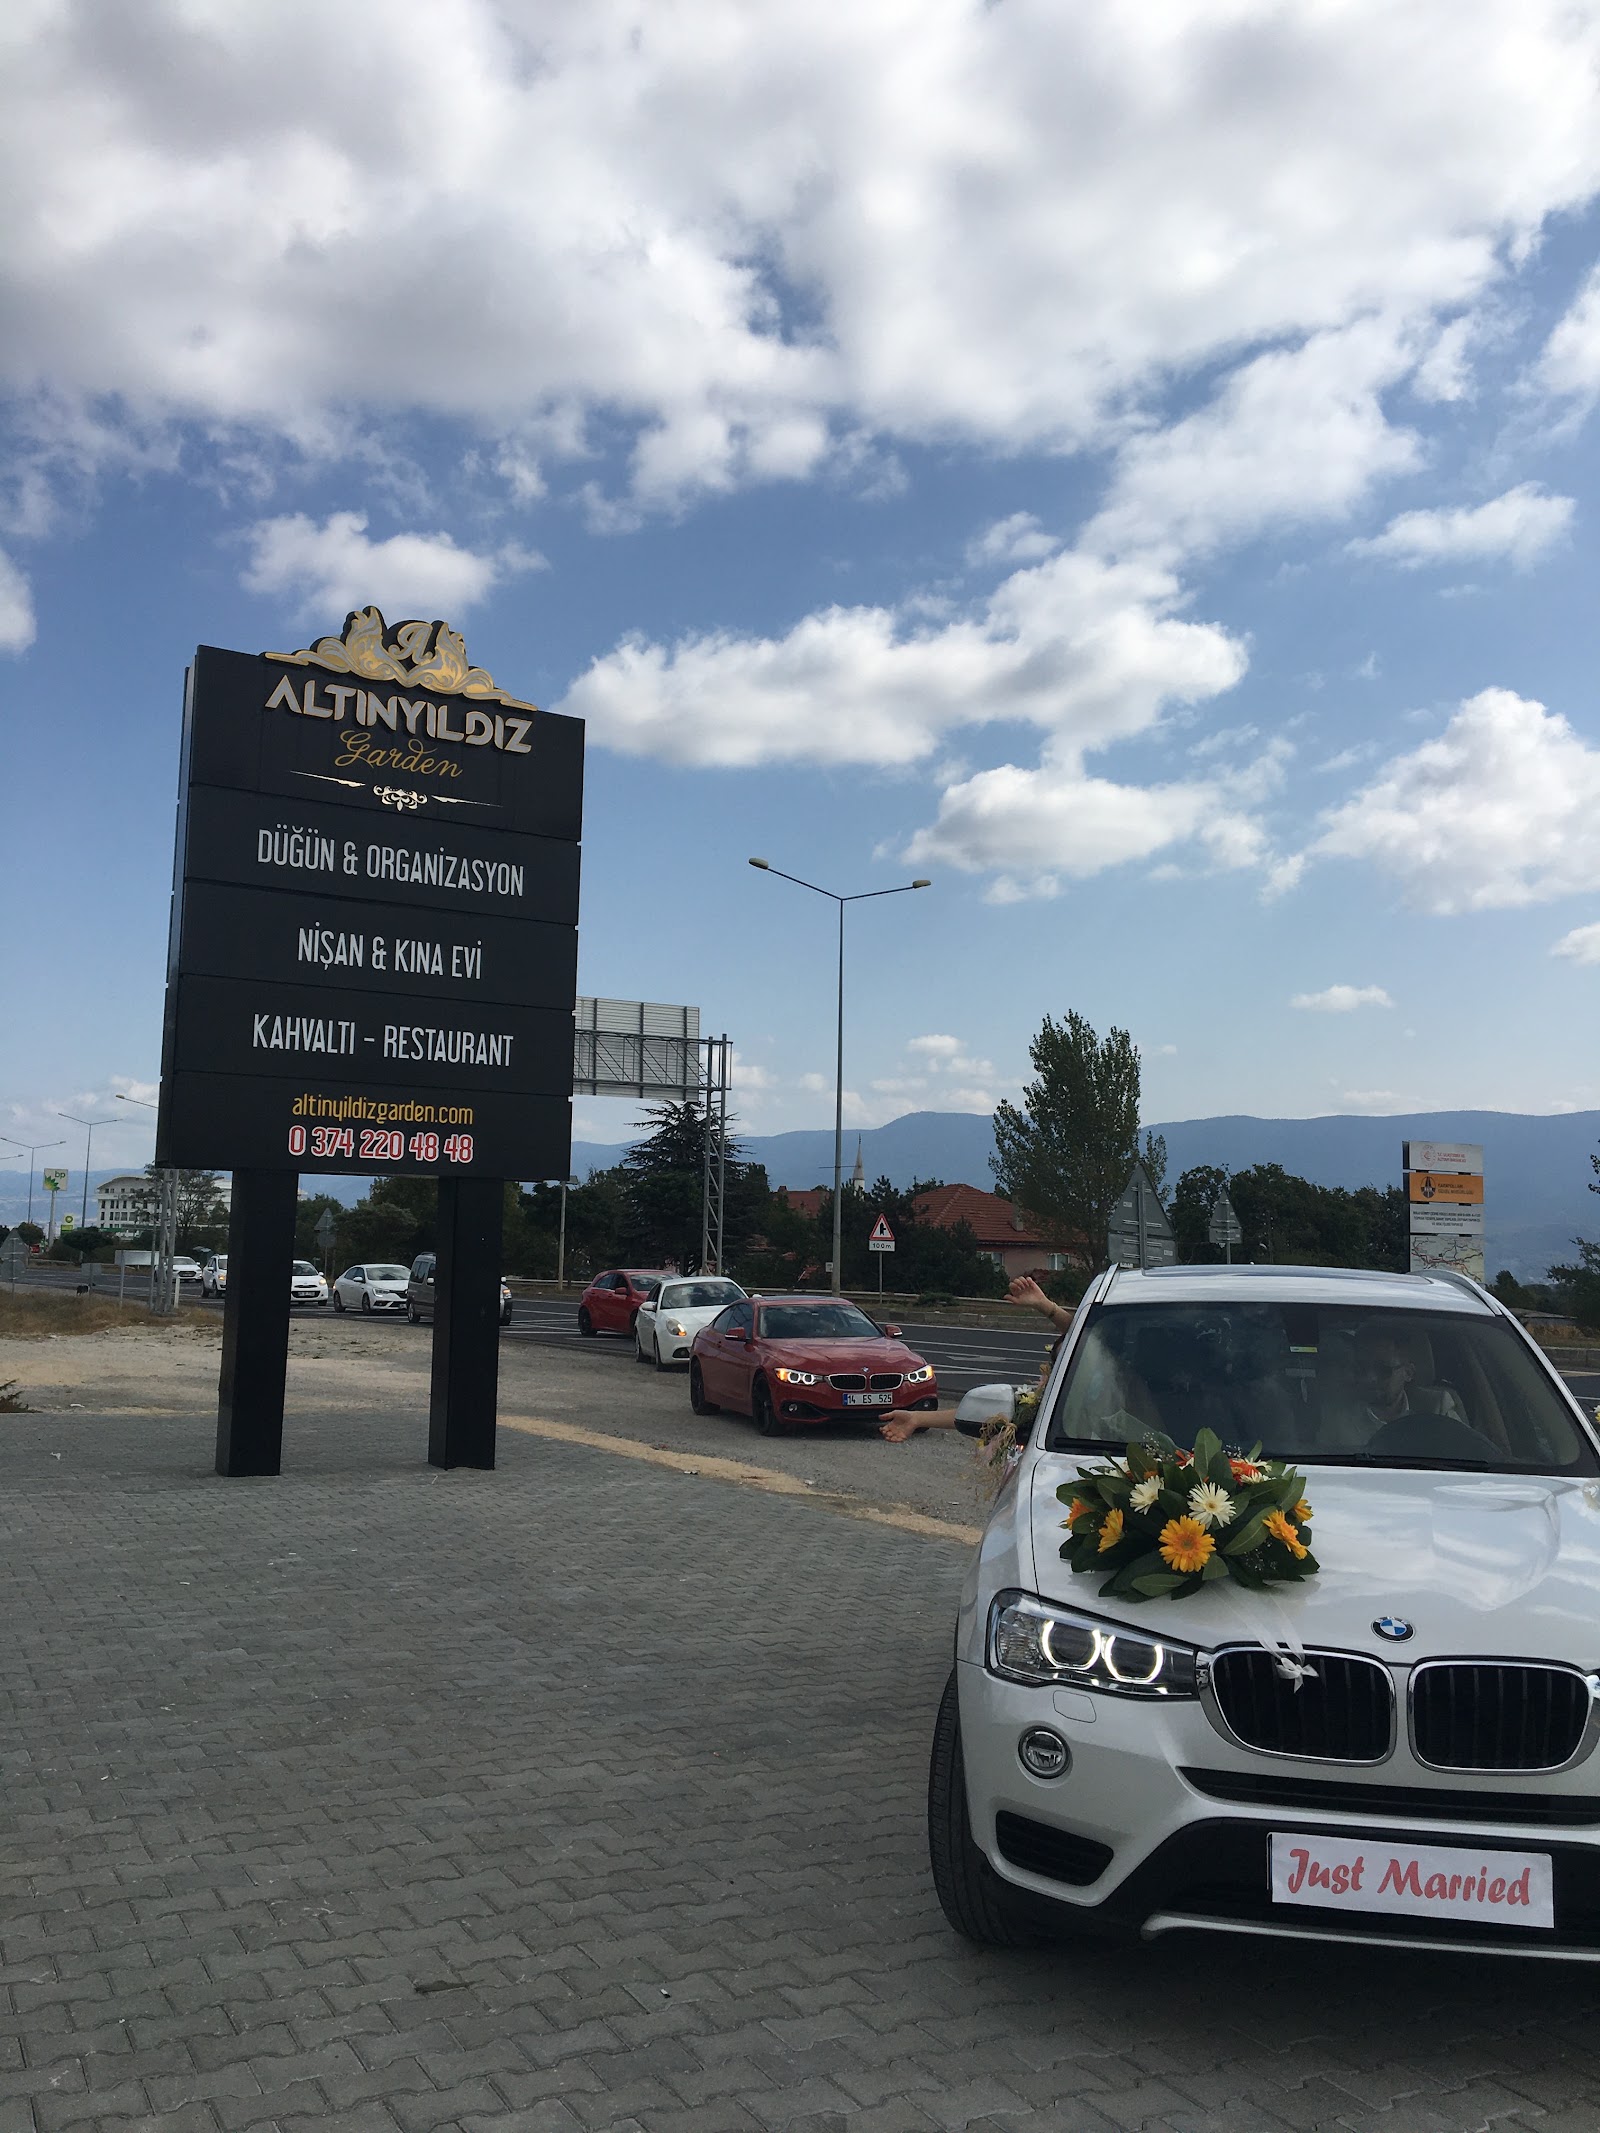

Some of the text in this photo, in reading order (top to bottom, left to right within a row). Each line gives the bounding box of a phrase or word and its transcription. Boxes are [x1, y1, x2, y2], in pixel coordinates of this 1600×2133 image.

[265, 674, 532, 754] ALTINYILDIZ
[334, 729, 463, 778] Garden
[257, 823, 524, 897] DÜĞÜN & ORGANİZASYON
[298, 921, 482, 980] NİŞAN & KINA EVİ
[252, 1013, 356, 1055] KAHVALTI
[383, 1024, 514, 1066] RESTAURANT
[292, 1093, 473, 1125] altinyildizgarden.com
[289, 1125, 473, 1163] 0 374 220 48 48
[54, 1171, 66, 1179] bp
[847, 1394, 892, 1404] 14 ES 525
[1288, 1848, 1531, 1906] Just Married
